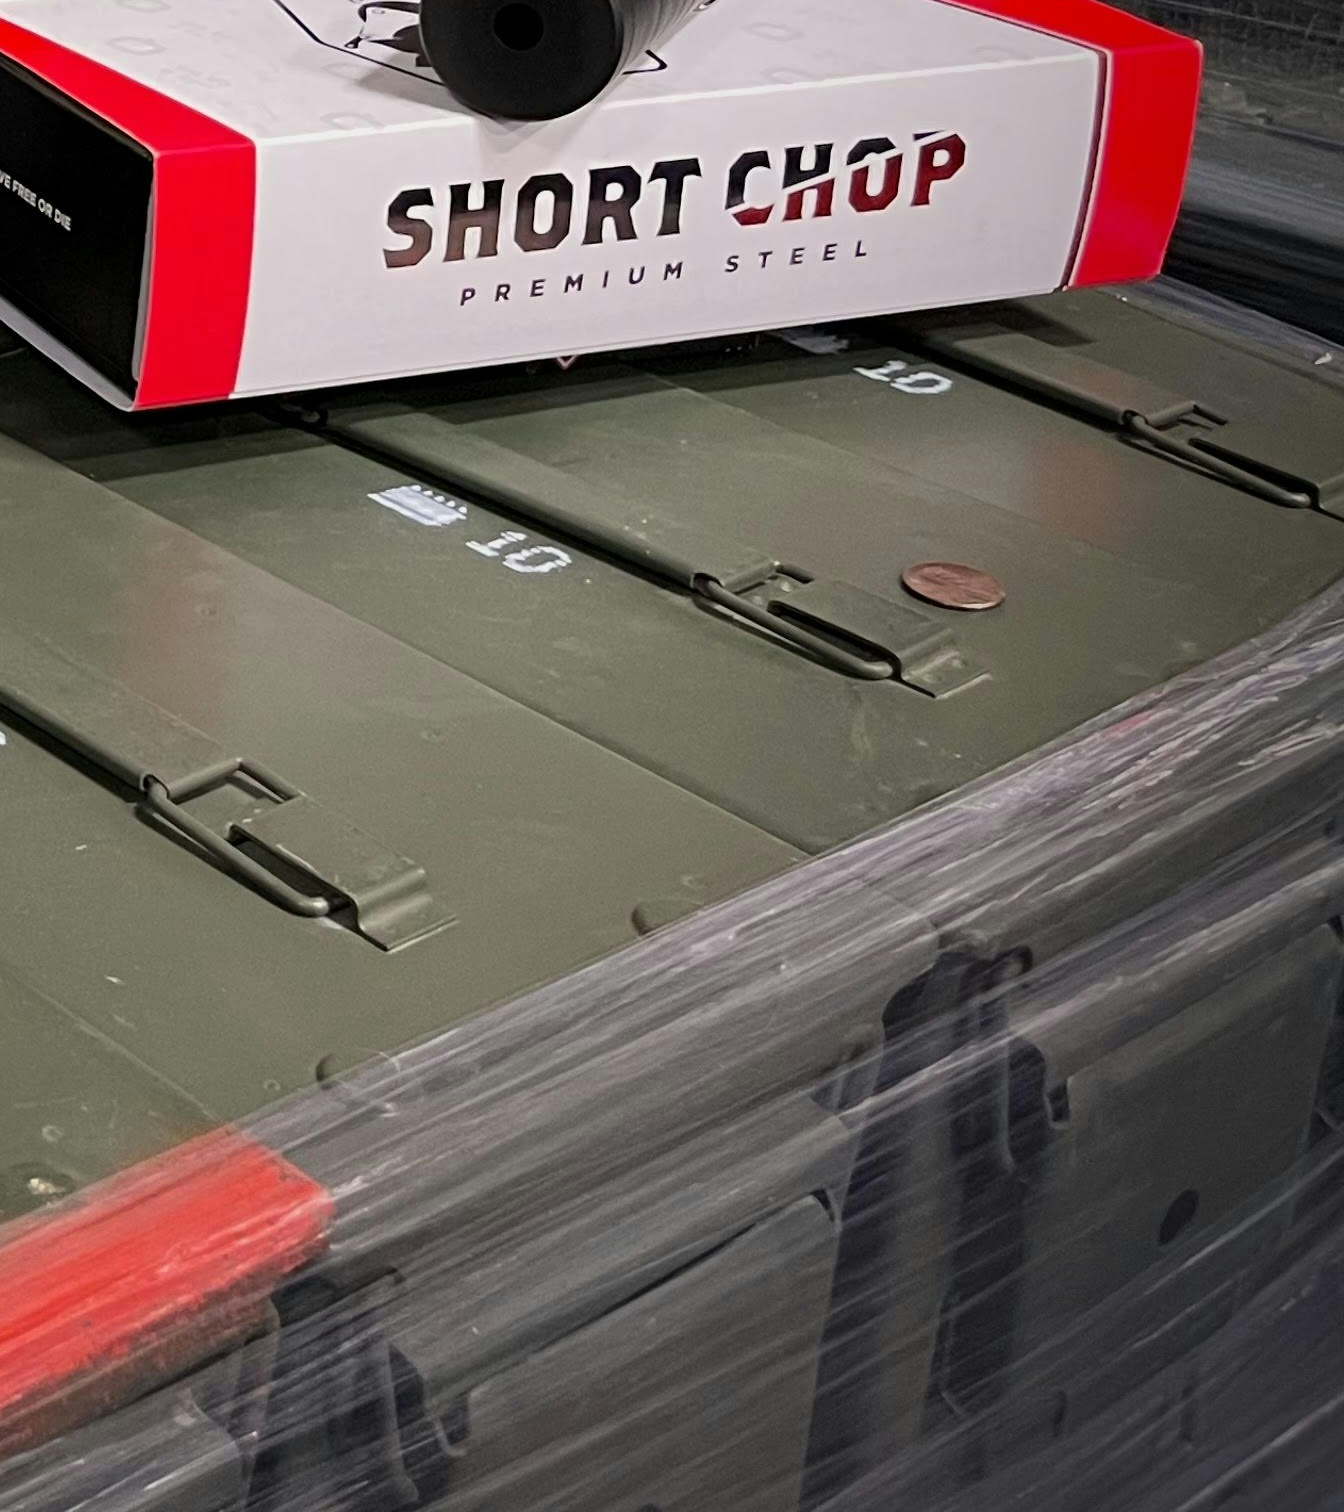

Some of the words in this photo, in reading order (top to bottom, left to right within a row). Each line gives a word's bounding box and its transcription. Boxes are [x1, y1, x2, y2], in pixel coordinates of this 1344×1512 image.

[12, 179, 37, 208] FREE
[38, 198, 53, 219] OR
[54, 208, 72, 232] DIE
[383, 156, 703, 269] SHORT
[725, 130, 967, 228] CHOP
[459, 261, 685, 307] PREMIUM
[724, 241, 871, 274] STEEL
[853, 357, 954, 396] 10
[466, 531, 573, 574] 10
